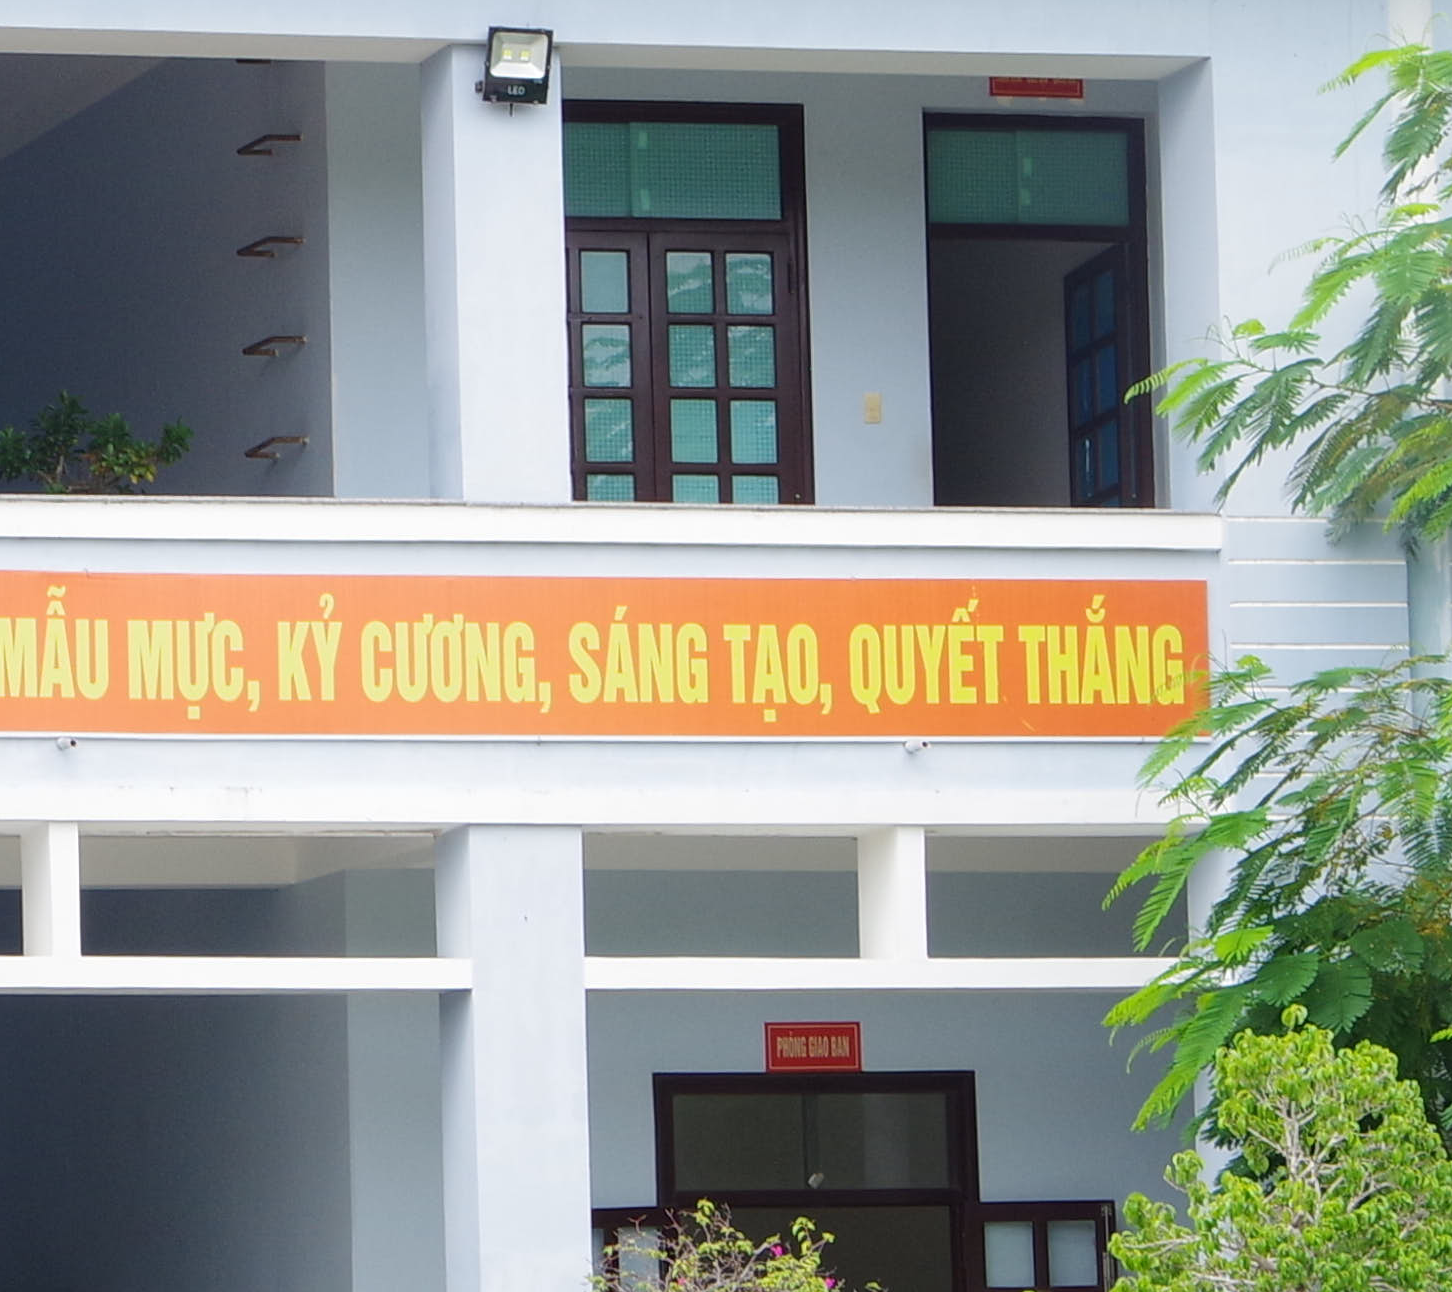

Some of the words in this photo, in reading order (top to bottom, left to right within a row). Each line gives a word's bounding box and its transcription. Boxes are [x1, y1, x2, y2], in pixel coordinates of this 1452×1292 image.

[128, 611, 260, 720] MỰC,
[277, 593, 344, 702] KỶ
[359, 613, 551, 714] CƯƠNG,
[568, 605, 708, 705] SÁNG
[723, 623, 832, 723] TẠO,
[849, 597, 1005, 714] QUYẾT
[1018, 594, 1184, 706] THẮNG
